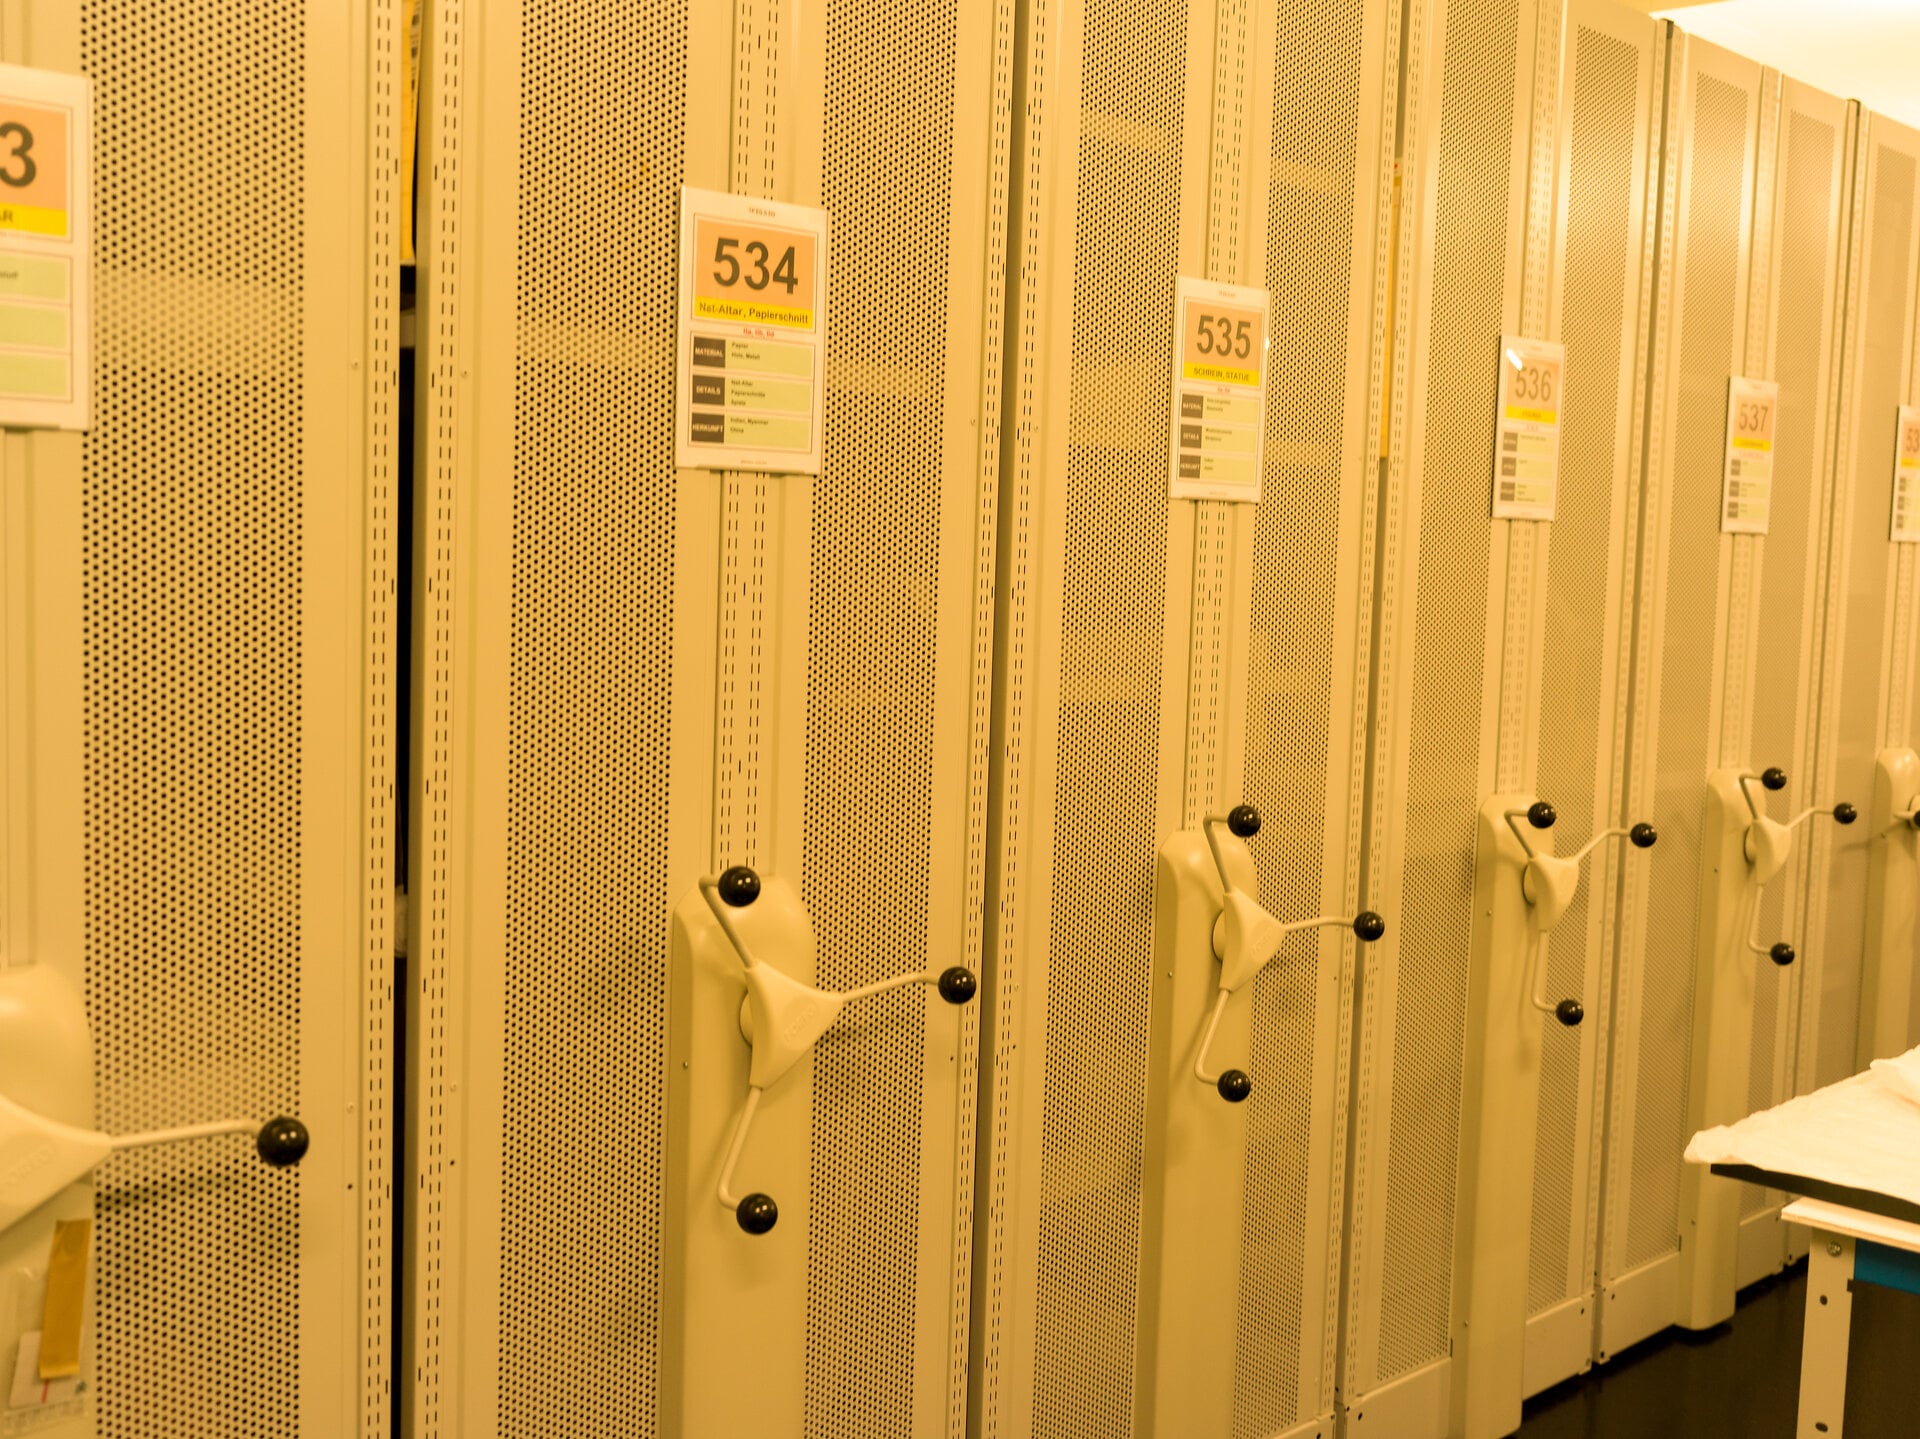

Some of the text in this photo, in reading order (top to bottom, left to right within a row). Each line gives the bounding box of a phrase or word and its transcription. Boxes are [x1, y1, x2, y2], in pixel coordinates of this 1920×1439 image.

[713, 237, 798, 295] 534
[749, 307, 809, 324] Papierschnitt
[1196, 314, 1251, 359] 535
[696, 385, 721, 395] DETAILS
[1514, 366, 1552, 402] 536
[1738, 403, 1769, 433] 537
